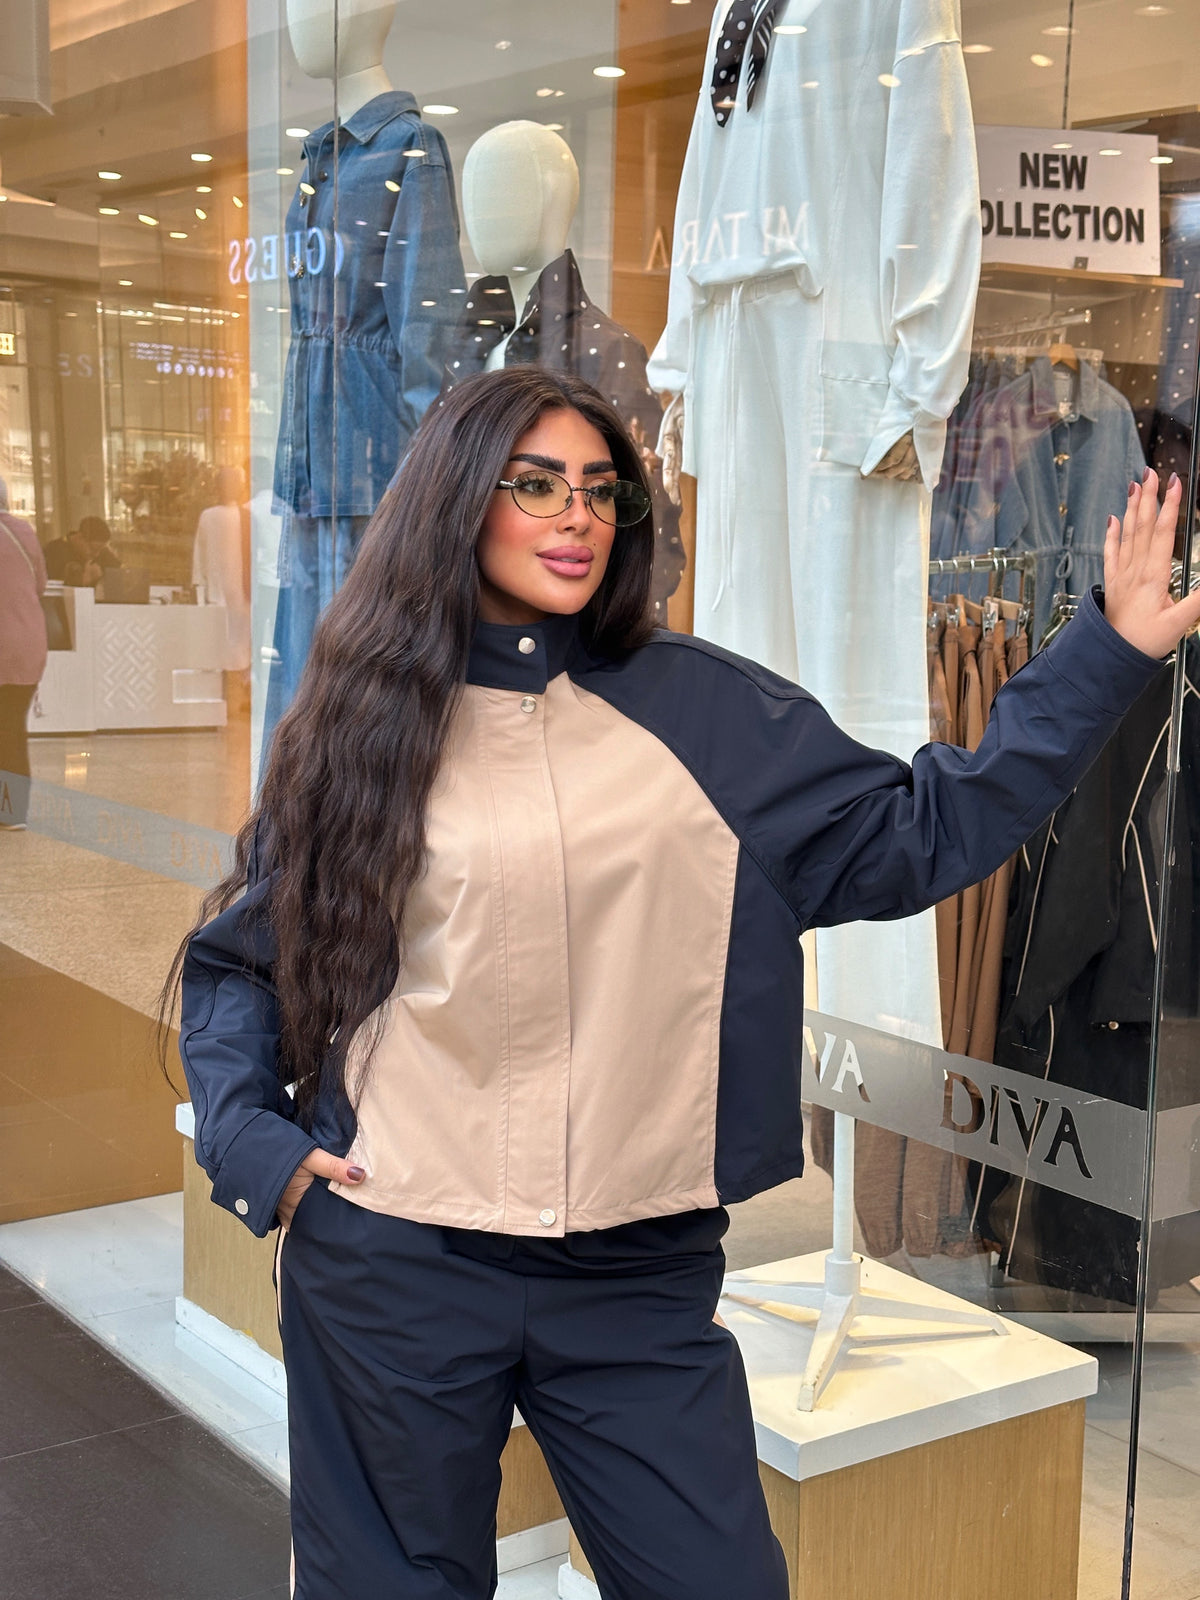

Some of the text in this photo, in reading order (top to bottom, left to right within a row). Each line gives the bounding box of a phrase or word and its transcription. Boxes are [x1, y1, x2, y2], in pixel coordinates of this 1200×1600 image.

[1020, 152, 1088, 190] NEW
[980, 199, 1145, 243] OLLECTION
[97, 810, 145, 856] DIVA
[170, 830, 225, 881] DIVA
[803, 1026, 1094, 1179] VA DIVA
